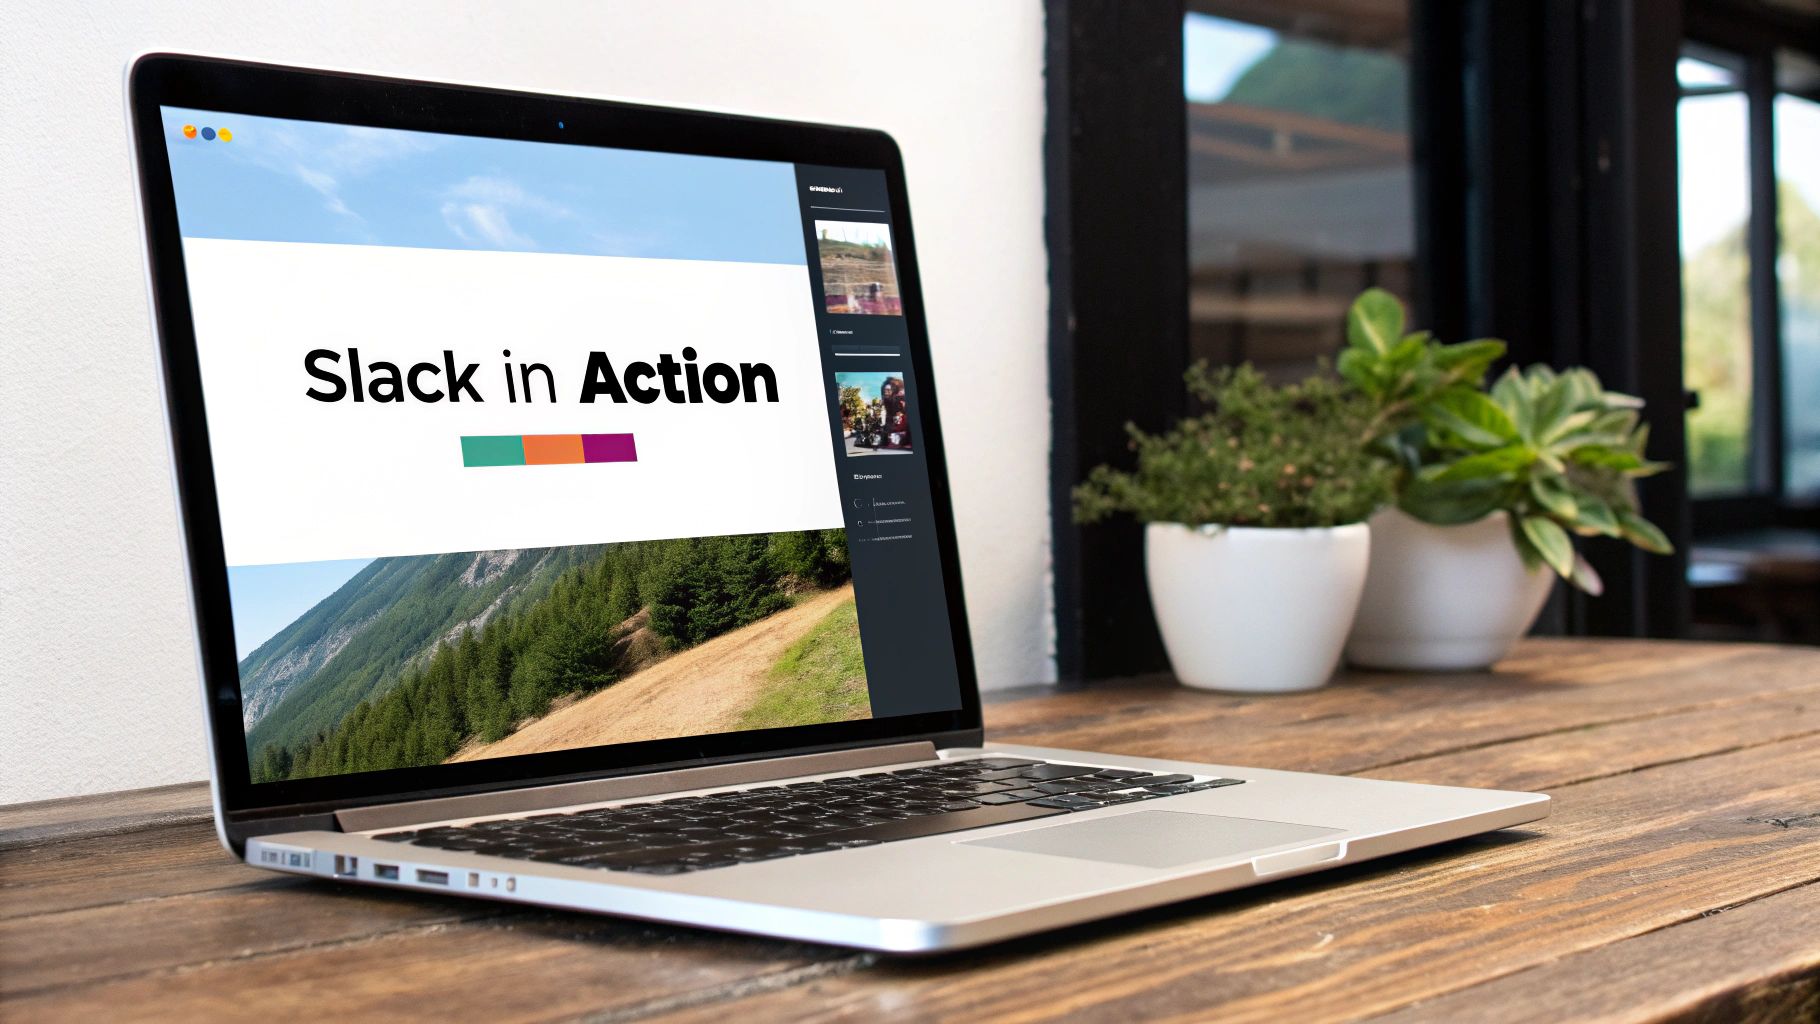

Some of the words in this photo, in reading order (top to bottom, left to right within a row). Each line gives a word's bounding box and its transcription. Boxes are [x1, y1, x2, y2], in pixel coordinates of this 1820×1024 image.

[304, 347, 485, 404] Slack
[502, 349, 557, 404] in
[579, 346, 780, 405] Action
